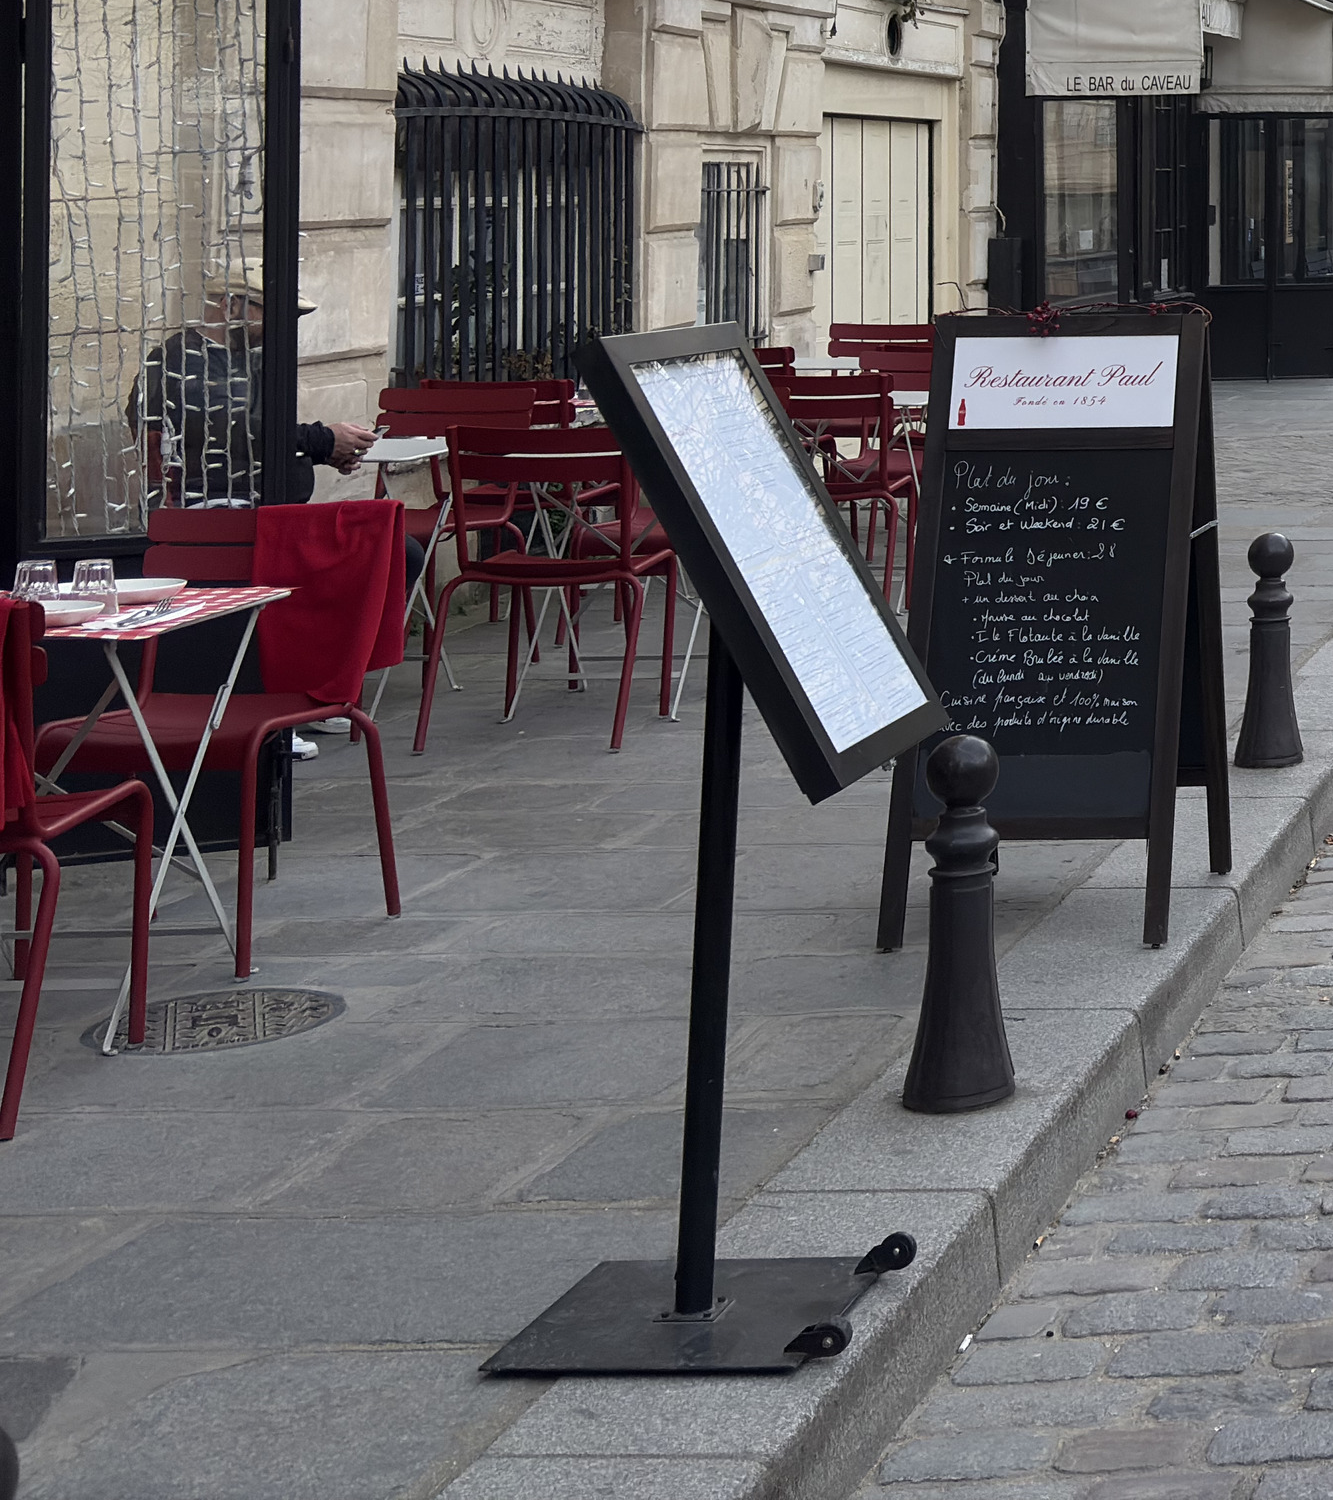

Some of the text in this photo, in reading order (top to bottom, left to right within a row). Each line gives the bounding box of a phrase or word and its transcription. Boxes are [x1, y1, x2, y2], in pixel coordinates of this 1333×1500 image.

[1066, 75, 1192, 92] LE BAR du CAVEAU
[963, 360, 1164, 389] Restaurant Paul
[1012, 396, 1049, 407] Fondé
[1072, 395, 1107, 407] 1854
[953, 460, 993, 489] Plat
[996, 466, 1017, 488] du
[963, 497, 1012, 513] Semaine
[965, 517, 992, 534] Soir
[999, 517, 1015, 531] et
[997, 571, 1014, 583] du
[1015, 575, 1045, 587] jour
[972, 595, 990, 604] un
[1042, 593, 1060, 602] au
[1020, 613, 1038, 622] au
[1042, 607, 1091, 622] chocolat
[1081, 624, 1093, 642] la
[1082, 647, 1093, 663] la
[1037, 672, 1054, 683] au
[939, 690, 987, 708] Cuisine
[1053, 687, 1069, 706] et
[966, 715, 987, 730] des
[1085, 710, 1130, 726] durable
